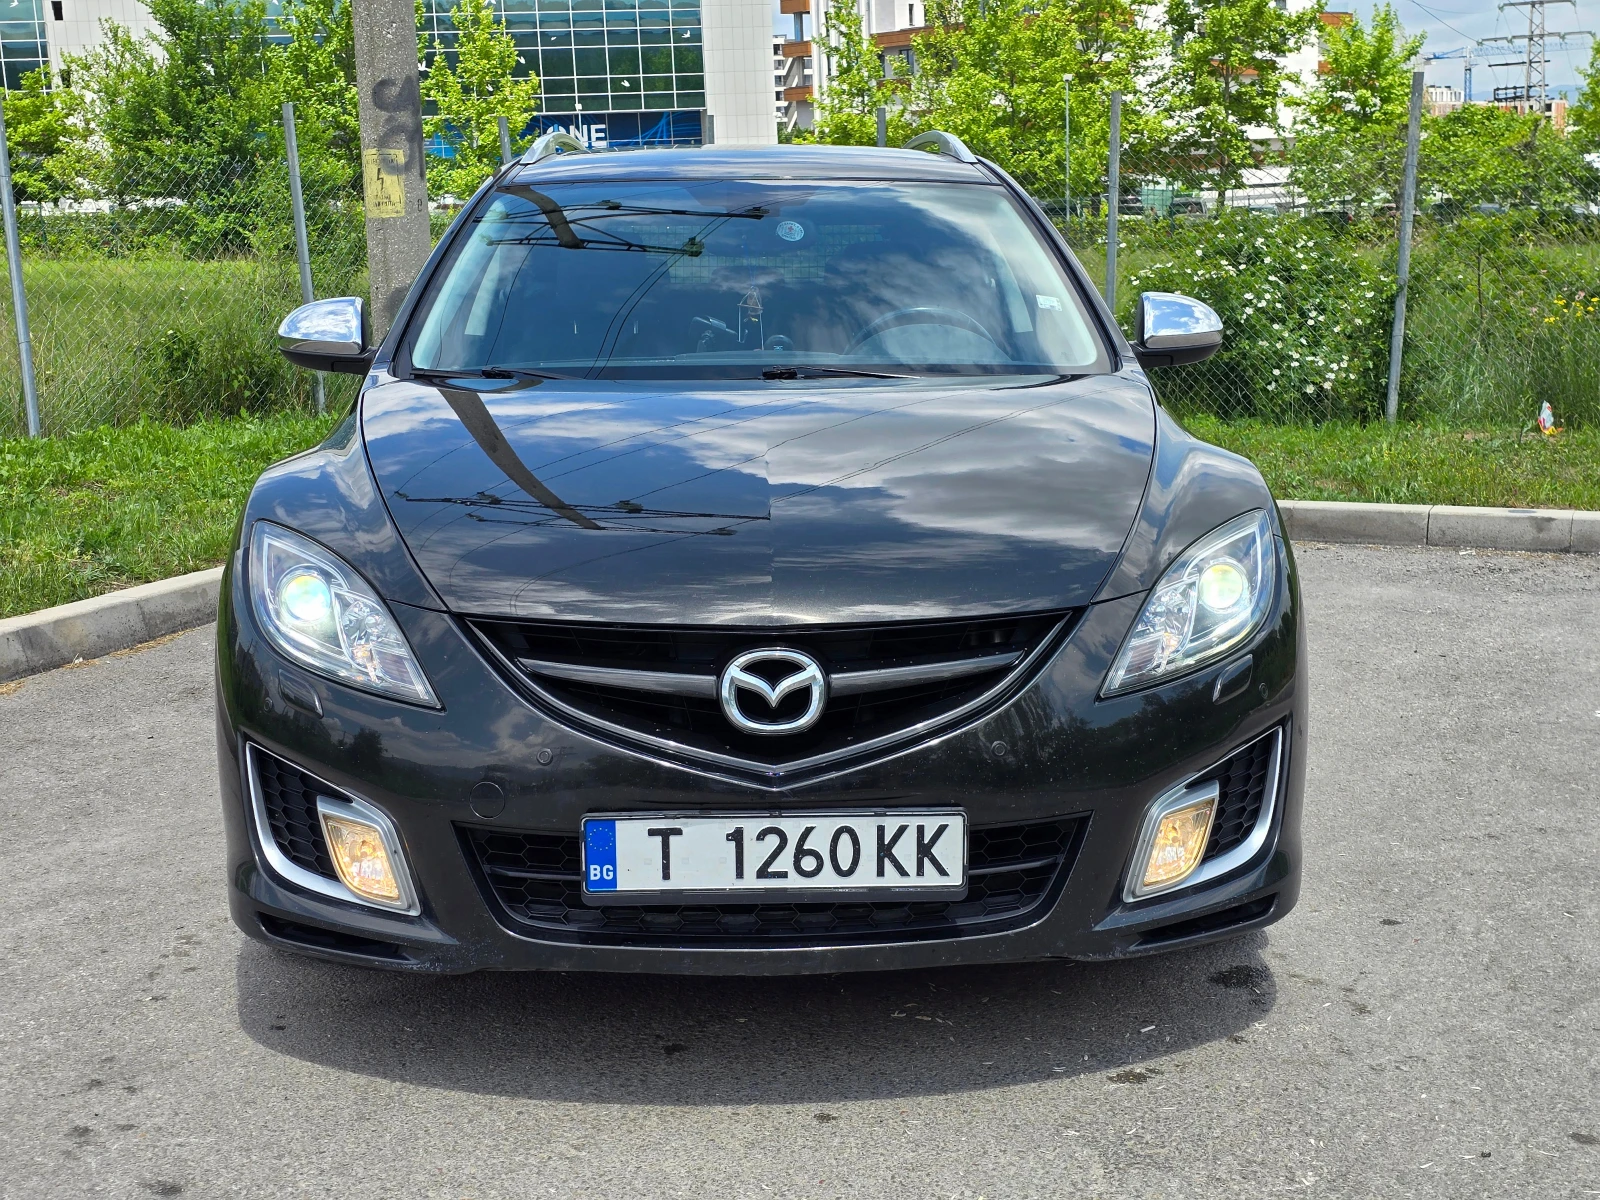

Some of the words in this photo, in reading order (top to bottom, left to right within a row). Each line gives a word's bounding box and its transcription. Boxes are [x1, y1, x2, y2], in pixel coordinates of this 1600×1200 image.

[647, 827, 683, 881] T
[725, 825, 861, 880] 1260
[589, 864, 614, 881] BG
